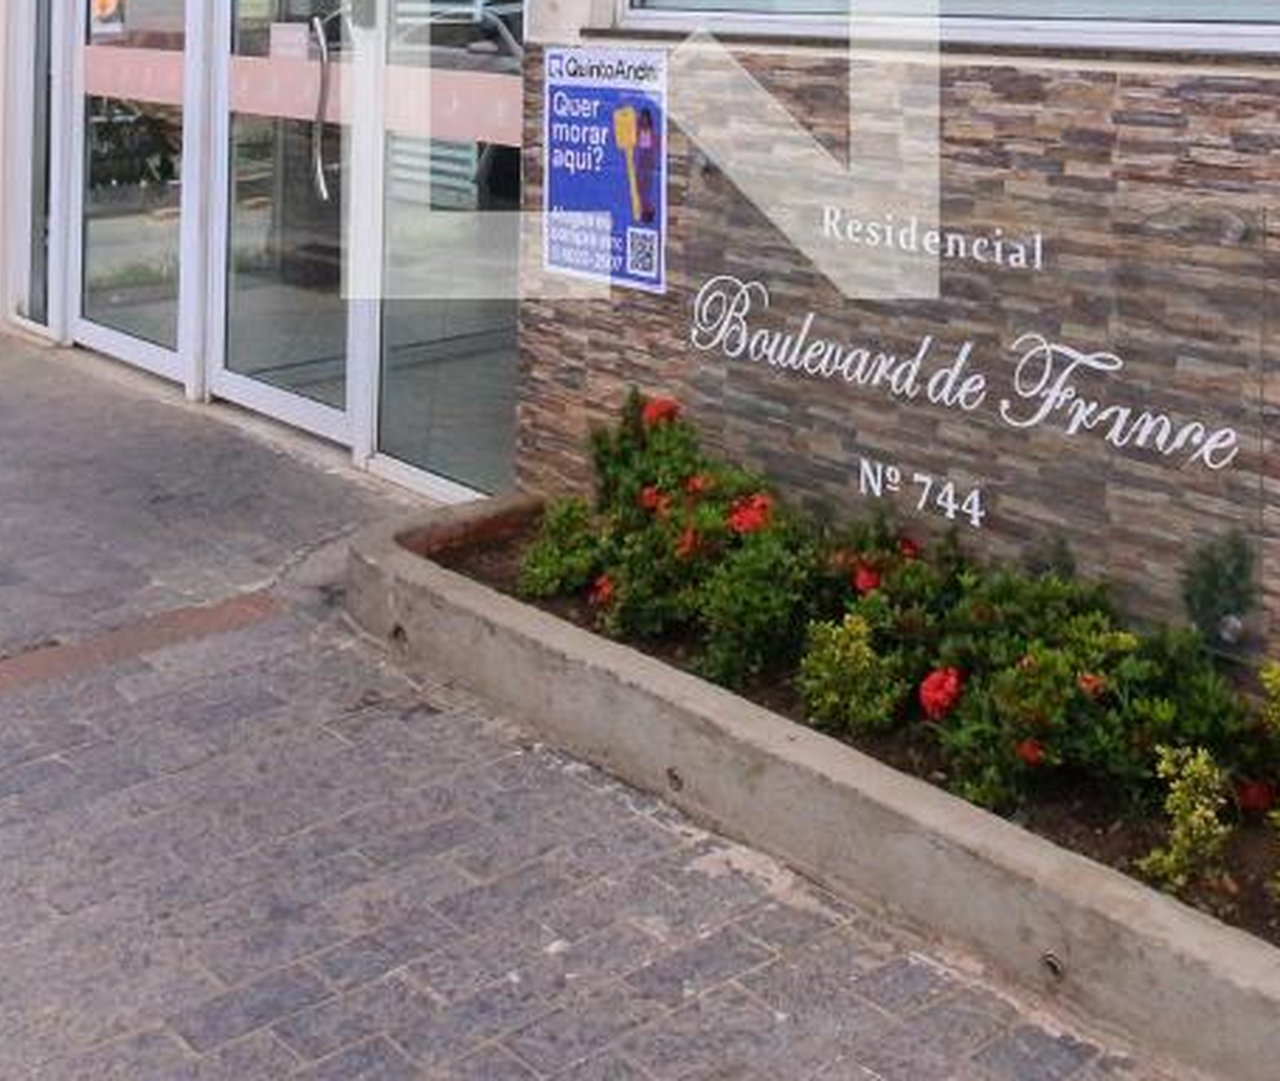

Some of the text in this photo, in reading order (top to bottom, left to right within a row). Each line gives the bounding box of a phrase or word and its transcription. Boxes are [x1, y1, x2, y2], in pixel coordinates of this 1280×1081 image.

[553, 92, 601, 119] Quer
[552, 125, 609, 146] morar
[552, 147, 605, 174] aqui?
[821, 205, 1045, 270] Residencial
[691, 275, 1240, 470] Boulevard de France
[912, 474, 985, 528] 744
